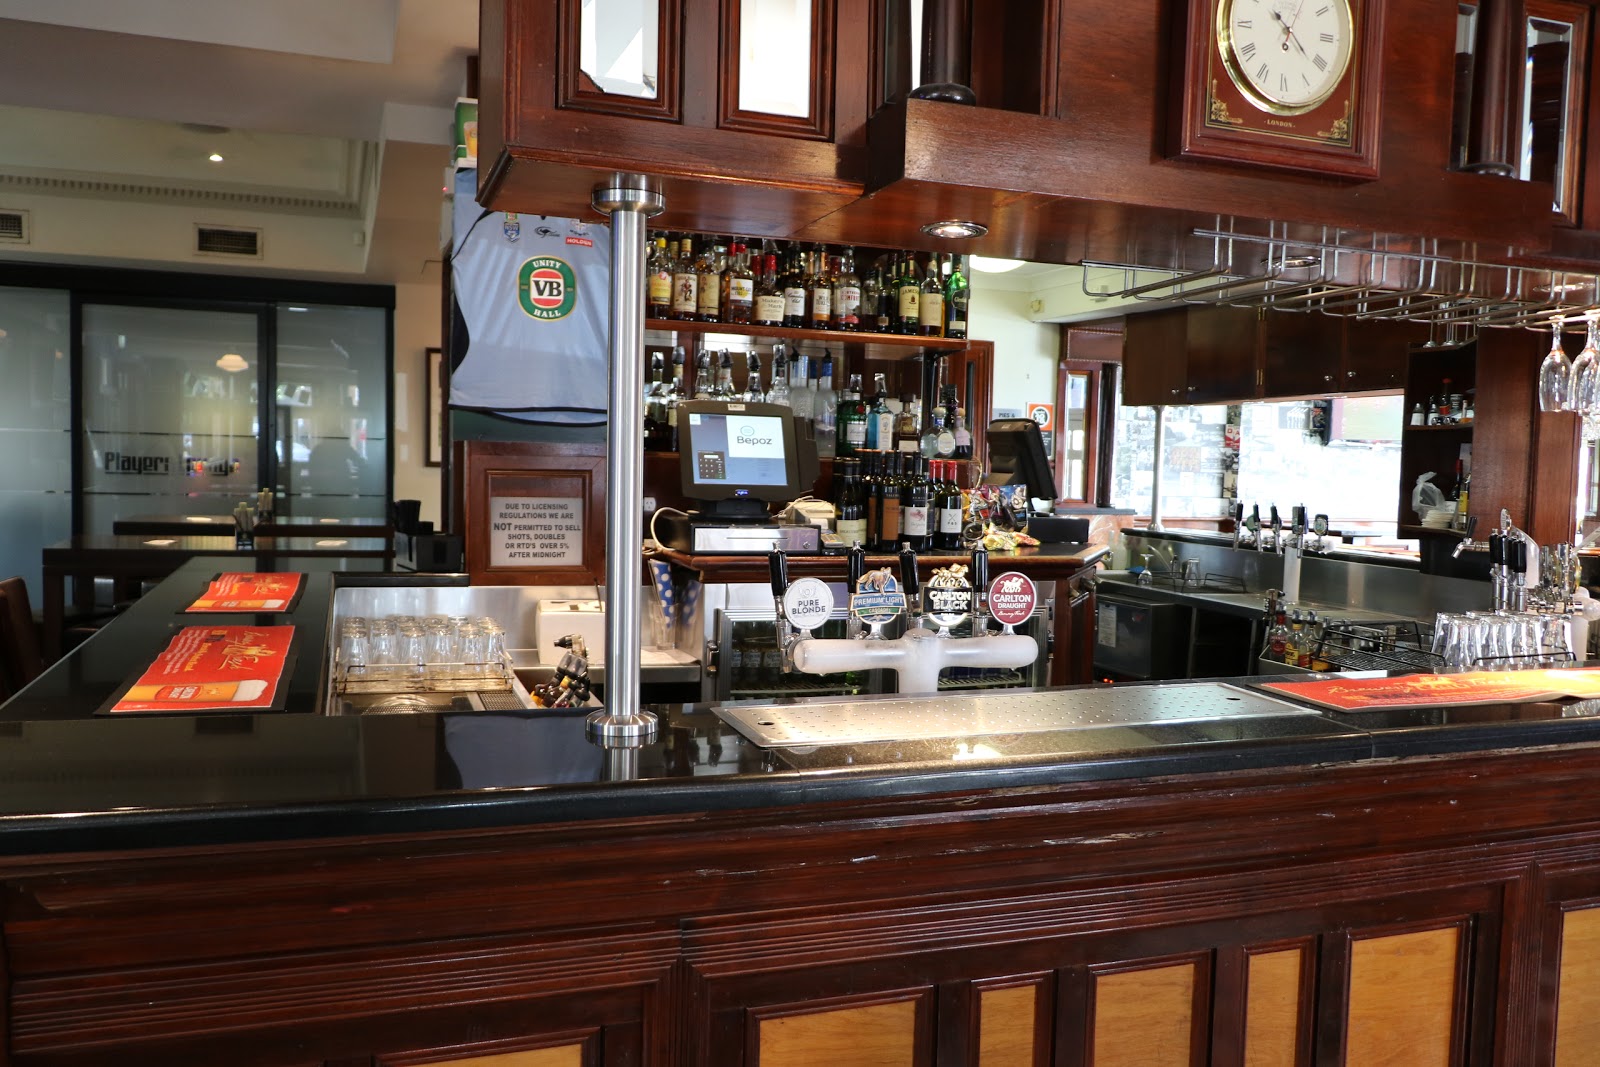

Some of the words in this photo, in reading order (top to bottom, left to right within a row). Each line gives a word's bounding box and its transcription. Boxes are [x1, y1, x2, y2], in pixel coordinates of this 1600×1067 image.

[1266, 119, 1292, 128] LONDON
[566, 238, 592, 246] HOLDEN
[532, 260, 562, 269] UNITY
[532, 280, 562, 297] VB
[533, 309, 561, 318] HALL
[736, 436, 773, 446] Bepoz
[494, 523, 512, 531] NOT
[930, 591, 971, 600] CARLTON
[993, 594, 1031, 602] CARLTON
[798, 599, 819, 607] PURE
[854, 597, 884, 605] PREMIUM
[885, 596, 903, 604] LIGHT
[933, 600, 968, 610] BLACK
[792, 606, 826, 615] BLONDE
